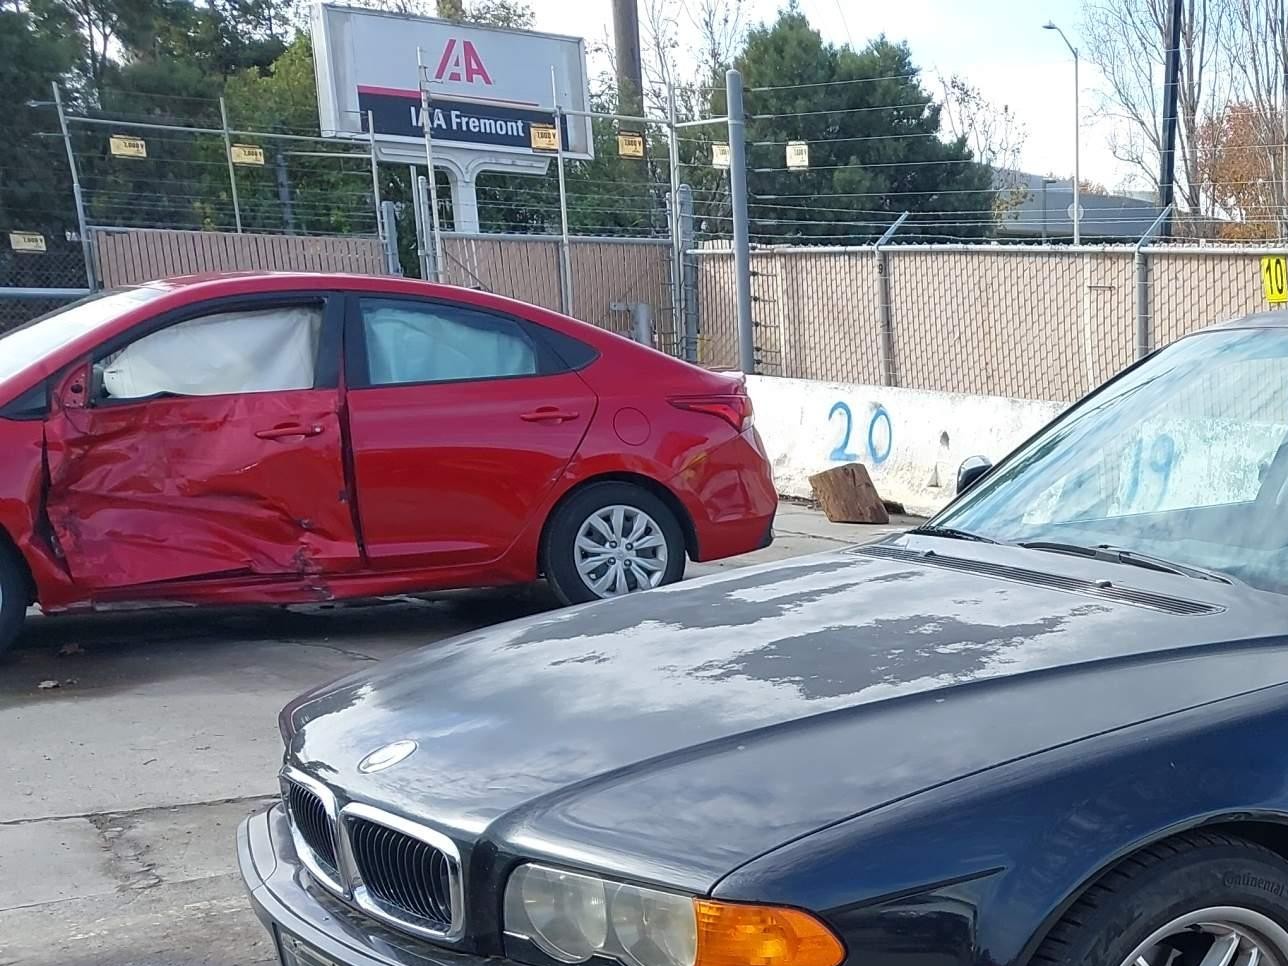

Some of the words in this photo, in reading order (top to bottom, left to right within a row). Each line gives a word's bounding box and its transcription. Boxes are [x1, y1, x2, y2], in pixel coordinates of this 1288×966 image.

[451, 110, 525, 137] Fremont
[1266, 258, 1284, 295] 10
[828, 401, 892, 464] 20
[1126, 432, 1175, 508] 19
